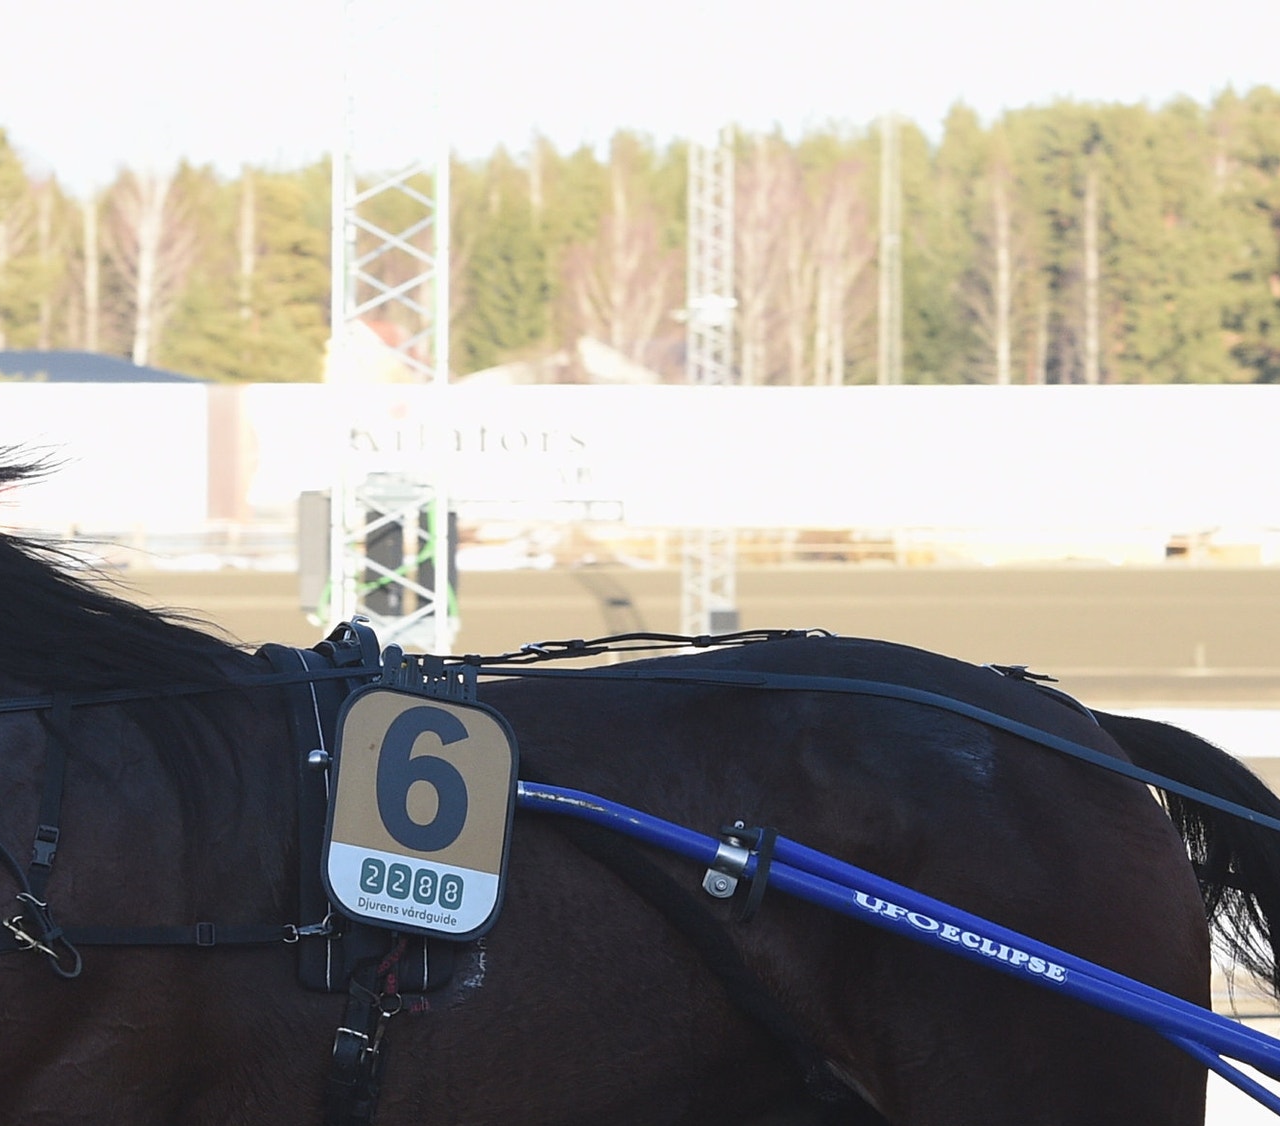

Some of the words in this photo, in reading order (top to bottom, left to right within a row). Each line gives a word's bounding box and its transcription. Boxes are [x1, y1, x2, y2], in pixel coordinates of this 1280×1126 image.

[376, 705, 469, 852] 6
[357, 896, 400, 916] Djurens
[401, 905, 458, 927] vårdguide
[363, 863, 460, 905] 2288
[855, 890, 940, 932] UFO
[941, 923, 1066, 982] ECLIPSE
